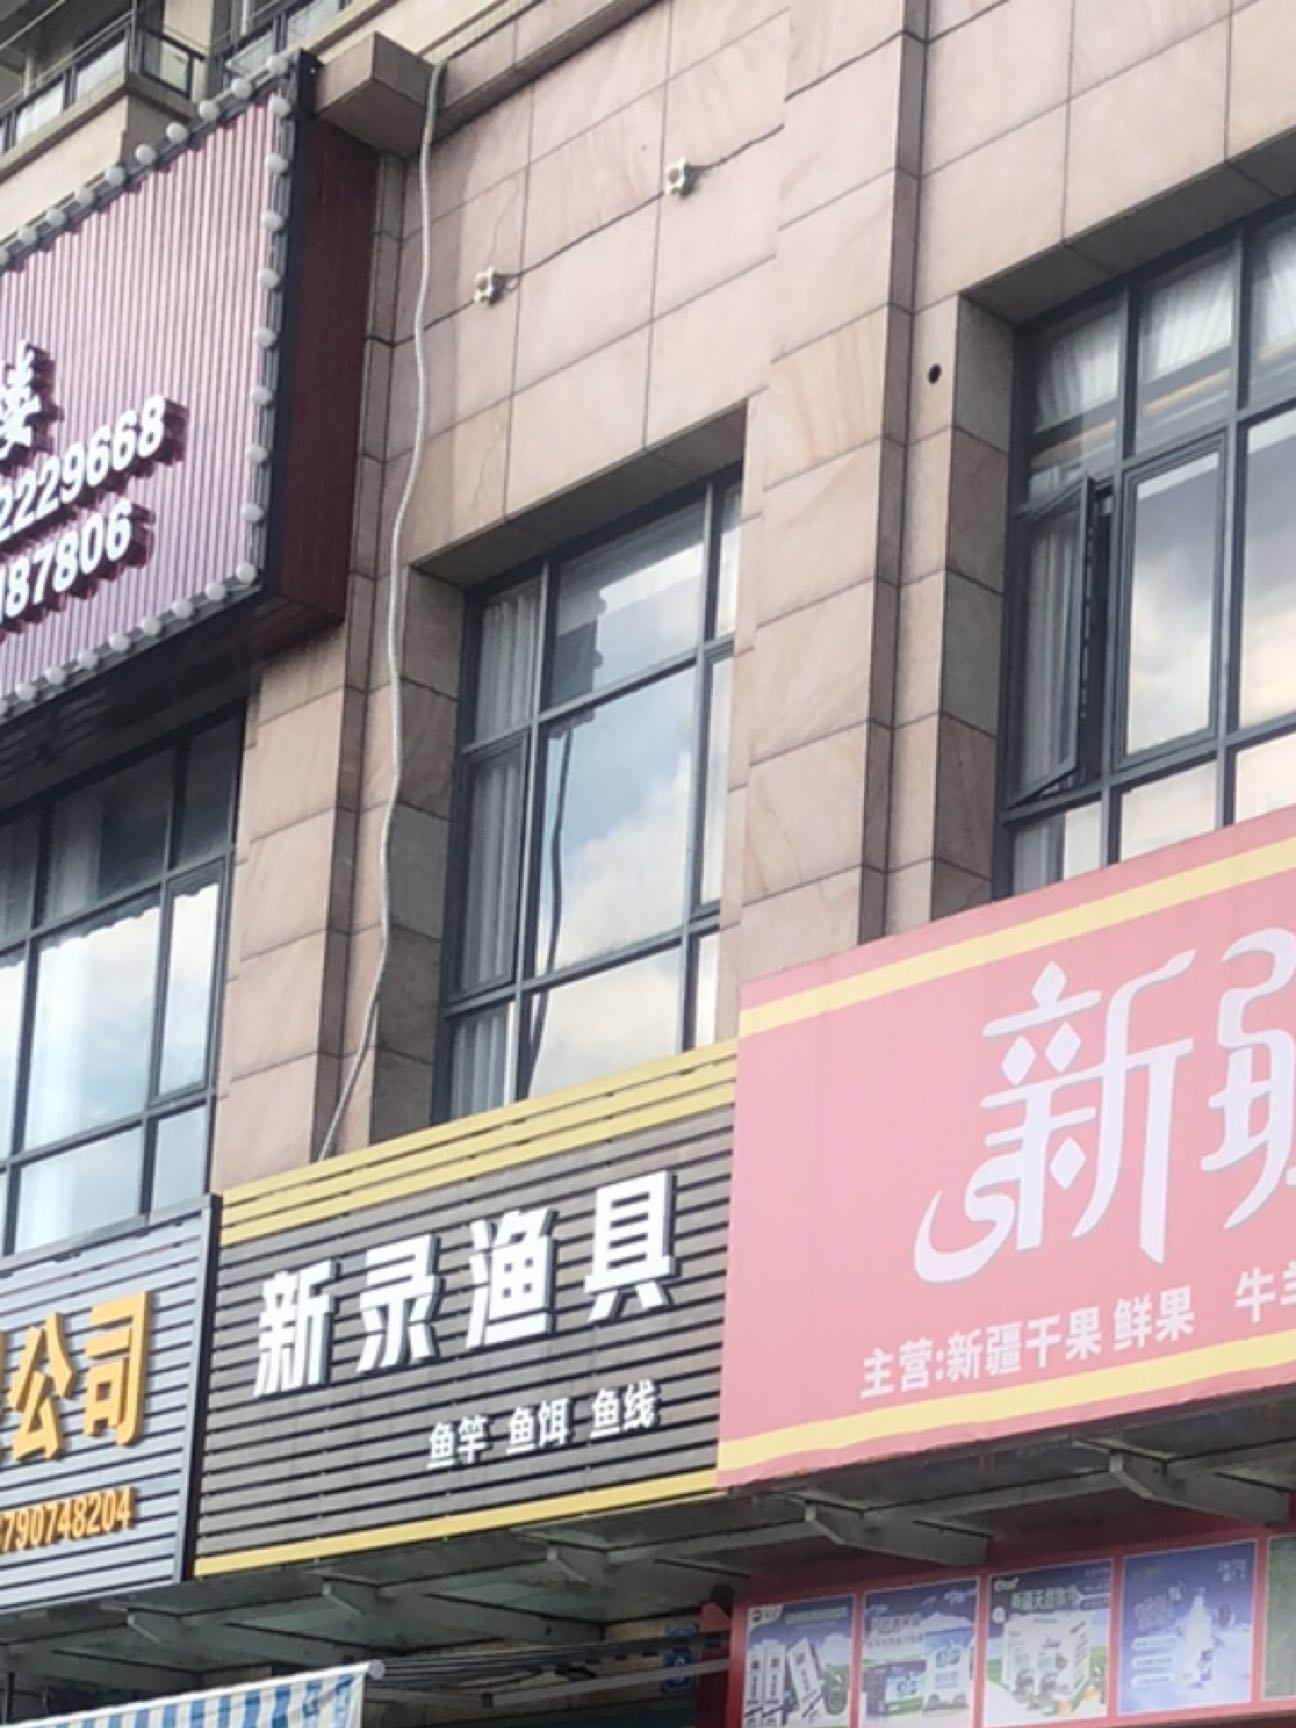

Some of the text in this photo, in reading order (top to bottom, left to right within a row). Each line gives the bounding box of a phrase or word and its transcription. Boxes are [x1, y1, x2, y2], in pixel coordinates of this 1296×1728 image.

[254, 1169, 679, 1399] 新录渔具
[427, 1378, 658, 1471] 鱼竿 鱼饵 鱼线
